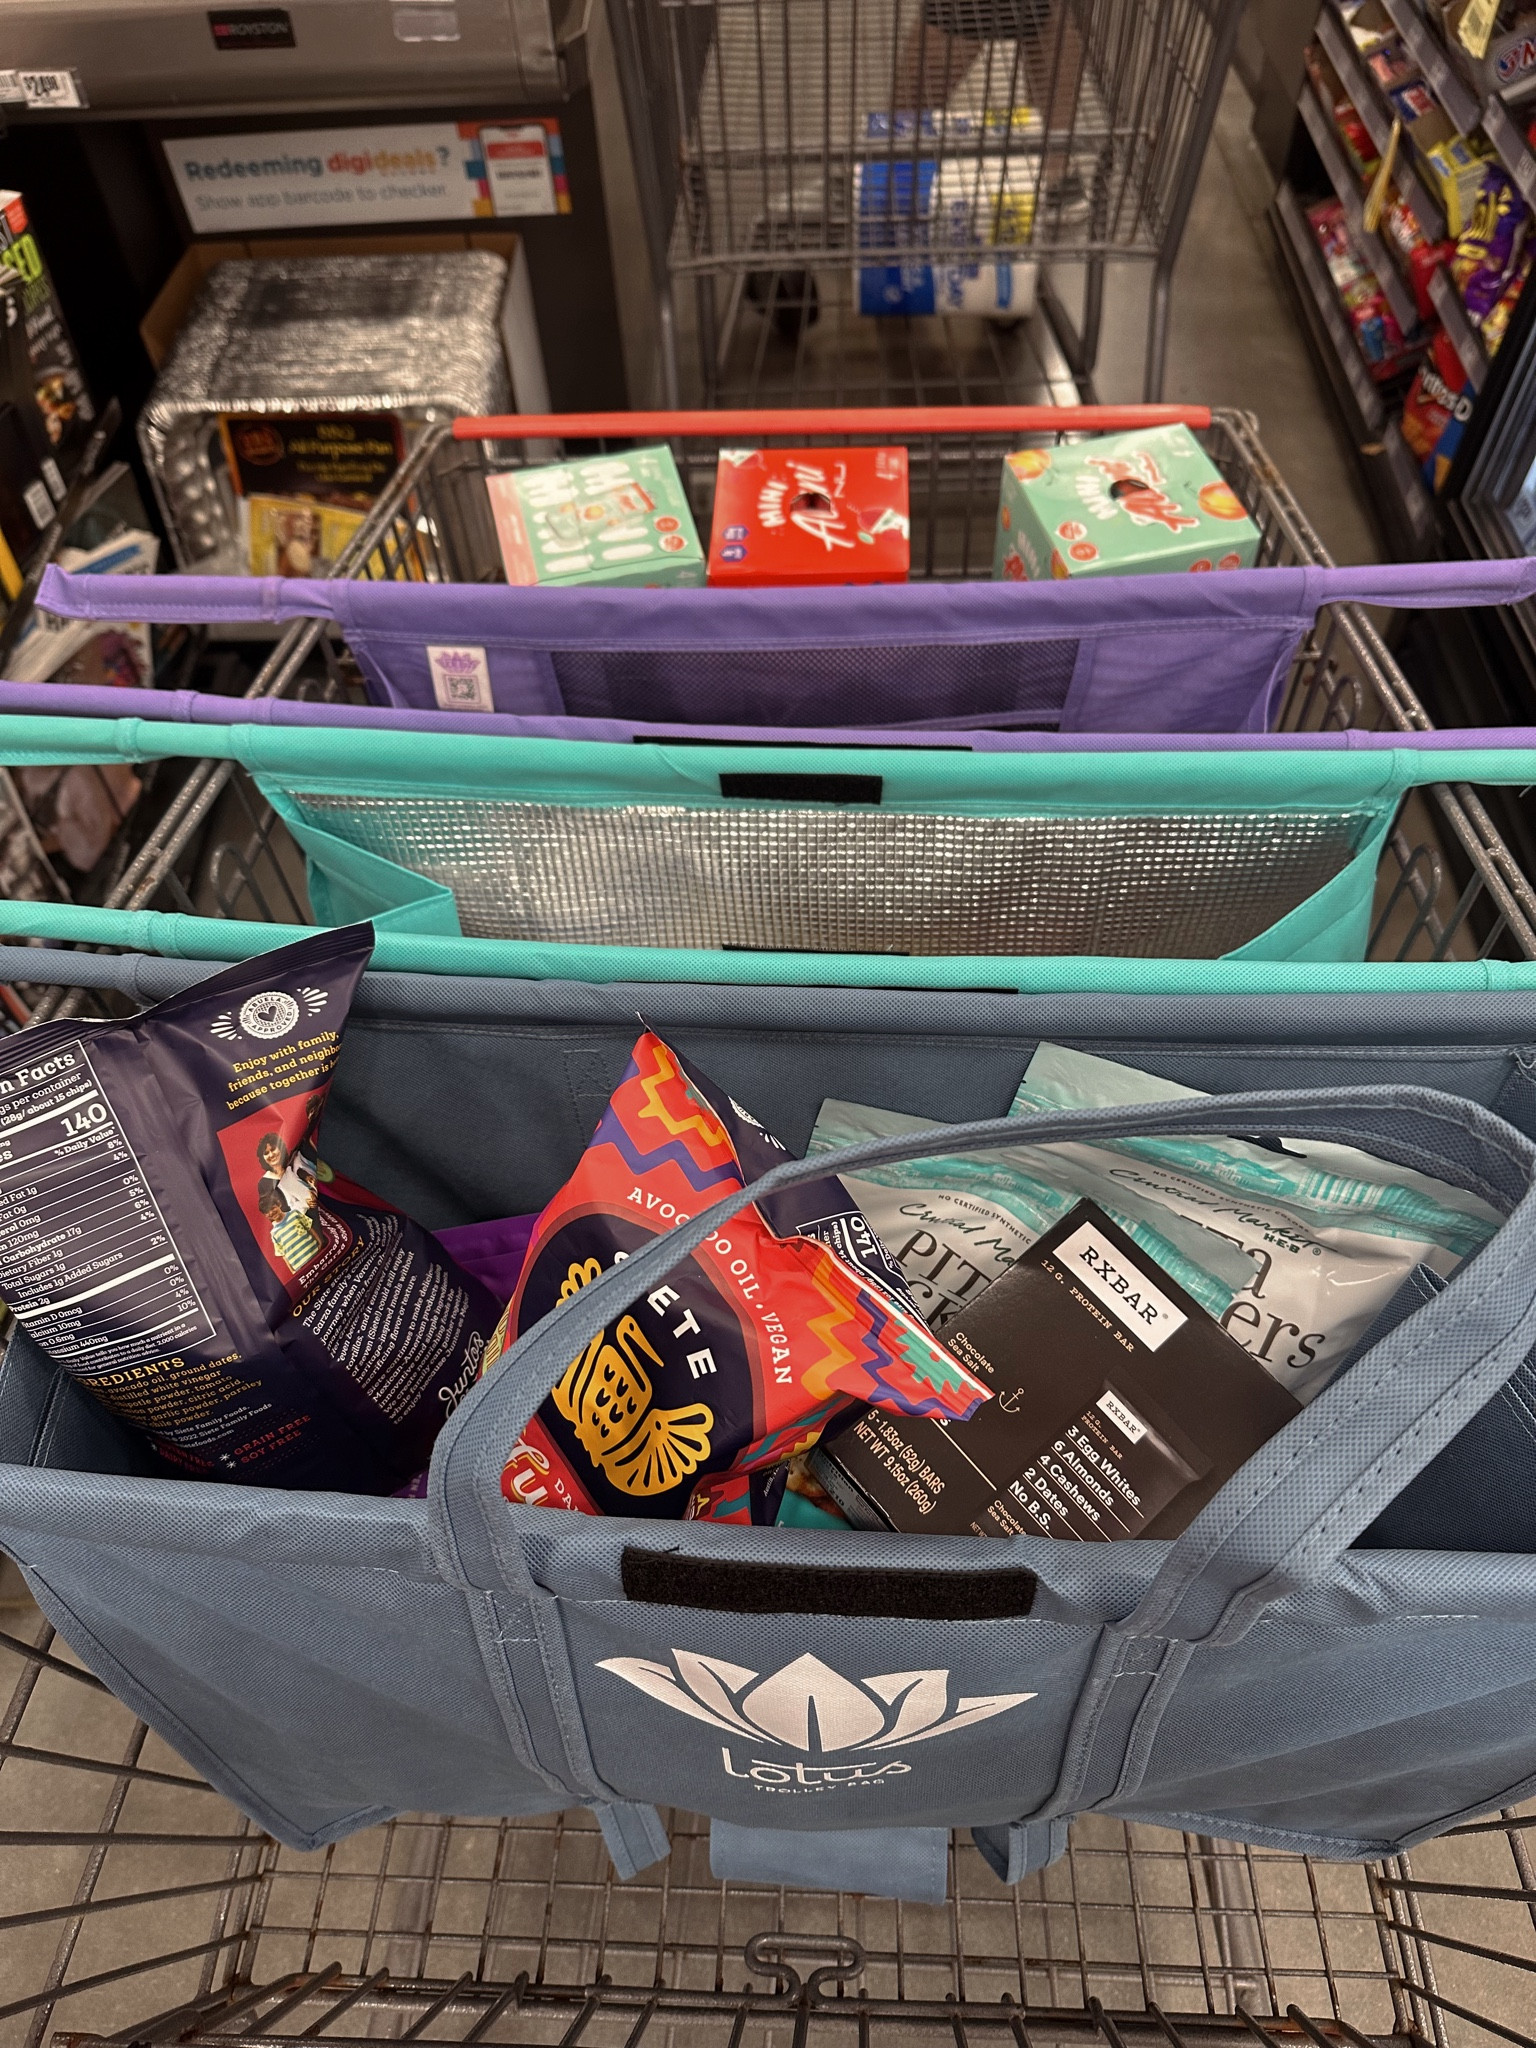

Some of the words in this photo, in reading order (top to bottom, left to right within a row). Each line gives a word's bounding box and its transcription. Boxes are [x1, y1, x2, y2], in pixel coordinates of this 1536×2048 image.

[184, 154, 323, 182] Redeeming
[194, 194, 244, 212] Show
[247, 191, 280, 210] app
[282, 187, 354, 206] barcode
[356, 186, 377, 201] to
[379, 182, 447, 200] checker
[757, 480, 790, 529] MINI
[785, 459, 857, 552] Alni
[248, 996, 282, 1012] ABUELA
[251, 1011, 293, 1033] APPROVED
[233, 1056, 267, 1073] Enjoy
[269, 1045, 297, 1061] with
[298, 1031, 339, 1050] family,
[15, 1053, 75, 1087] Facts
[226, 1086, 268, 1111] because
[270, 1067, 320, 1090] together
[322, 1062, 329, 1073] is
[228, 1070, 274, 1092] friends,
[274, 1059, 298, 1074] and
[12, 1096, 31, 1109] per
[32, 1072, 81, 1099] container
[27, 1099, 55, 1114] about
[56, 1093, 66, 1103] 15
[66, 1079, 93, 1097] chips)
[61, 1103, 107, 1137] 140
[64, 1140, 89, 1154] Daily
[107, 1139, 122, 1149] 8%
[114, 1151, 128, 1161] 4%
[10, 1191, 25, 1202] Fat
[123, 1174, 139, 1186] 0%
[128, 1186, 144, 1198] 5%
[134, 1198, 149, 1209] 6%
[1108, 1168, 1219, 1207] Central
[1214, 1208, 1338, 1253] Market
[1152, 1169, 1167, 1177] NO
[1170, 1175, 1217, 1198] CERTIFIED
[1218, 1194, 1272, 1214] SYNTHETIC
[1274, 1208, 1310, 1233] COLORS
[19, 1214, 41, 1227] 0mg
[831, 1221, 842, 1250] chips)
[899, 1203, 986, 1234] Central
[954, 1198, 990, 1216] CERTIFIED
[991, 1212, 1032, 1245] SYNTHETIC
[3, 1234, 66, 1264] Carbohydrate
[66, 1226, 82, 1237] 17g
[8, 1230, 39, 1247] 120mg
[150, 1234, 166, 1246] 2%
[850, 1216, 879, 1259] 140
[27, 1253, 51, 1268] Fiber
[164, 1263, 179, 1275] 0%
[838, 1250, 846, 1261] 14
[896, 1229, 993, 1301] PIT
[2, 1277, 23, 1290] Total
[24, 1267, 55, 1283] Sugars
[18, 1282, 54, 1299] Includes
[64, 1266, 92, 1282] Added
[92, 1251, 124, 1270] Sugars
[169, 1275, 185, 1287] 0%
[293, 1285, 321, 1317] OUR
[324, 1235, 364, 1284] STORY
[342, 1285, 358, 1307] when
[353, 1247, 381, 1284] Veronica
[627, 1187, 733, 1255] AVOCO
[730, 1258, 760, 1300] OIL
[760, 1312, 793, 1384] VEGAN
[1079, 1245, 1158, 1325] RXBAR
[177, 1299, 196, 1312] 10%
[302, 1311, 317, 1328] The
[314, 1288, 331, 1310] Siete
[312, 1307, 332, 1335] Garza
[327, 1273, 351, 1308] family's
[1041, 1259, 1055, 1273] 12
[1054, 1272, 1065, 1284] G.
[1069, 1287, 1113, 1329] PROTEIN
[1113, 1331, 1135, 1353] BAR
[48, 1333, 75, 1346] 0.6mg
[59, 1320, 81, 1330] 10mg
[80, 1335, 109, 1347] 440mg
[356, 1306, 395, 1383] heritage-inspired
[359, 1340, 373, 1366] seven
[373, 1318, 427, 1403] Mexican-American
[386, 1331, 413, 1373] continues
[948, 1339, 966, 1357] Sea
[960, 1355, 980, 1373] Salt
[956, 1332, 995, 1374] Chocolate
[108, 1380, 149, 1394] avocado
[170, 1365, 207, 1380] ground
[362, 1341, 395, 1389] sacrificing
[396, 1372, 417, 1400] create
[416, 1325, 446, 1372] nourishing
[419, 1357, 447, 1391] because
[150, 1381, 180, 1393] white
[182, 1369, 222, 1385] vinegar
[195, 1375, 233, 1392] tomato
[223, 1379, 262, 1401] parsley
[379, 1363, 416, 1408] innovative
[195, 1416, 223, 1432] Family
[220, 1414, 247, 1430] Family
[247, 1402, 273, 1417] Foods
[1085, 1410, 1095, 1419] 12
[1105, 1400, 1137, 1434] RXBAR
[233, 1431, 276, 1456] GRAIN
[276, 1414, 312, 1436] FREE
[239, 1448, 266, 1464] SOY
[269, 1430, 302, 1450] FREE
[868, 1409, 880, 1421] 5
[877, 1420, 905, 1452] 1.83oz
[899, 1444, 926, 1473] (52g)
[919, 1465, 945, 1495] BARS
[1081, 1415, 1109, 1444] PROTEIN
[1108, 1445, 1124, 1460] BAR
[853, 1421, 876, 1443] NET
[869, 1437, 891, 1460] WT
[883, 1455, 912, 1488] 9.15oz
[905, 1480, 937, 1515] (260g)
[1053, 1440, 1066, 1452] 6
[1062, 1451, 1115, 1506] Almonds
[1068, 1425, 1080, 1438] 3
[1076, 1435, 1101, 1464] Egg
[1100, 1457, 1141, 1506] Whites
[1009, 1479, 1028, 1502] No
[1027, 1500, 1051, 1530] B.S.
[1024, 1467, 1037, 1481] 2
[1034, 1476, 1069, 1517] Dates
[1039, 1454, 1051, 1466] 4
[1050, 1463, 1101, 1522] Cashews
[969, 1521, 981, 1532] NET
[987, 1505, 1000, 1518] Sea
[999, 1519, 1015, 1535] Salt
[754, 1784, 837, 1794] TROLLEY
[847, 1778, 885, 1787] BAG
